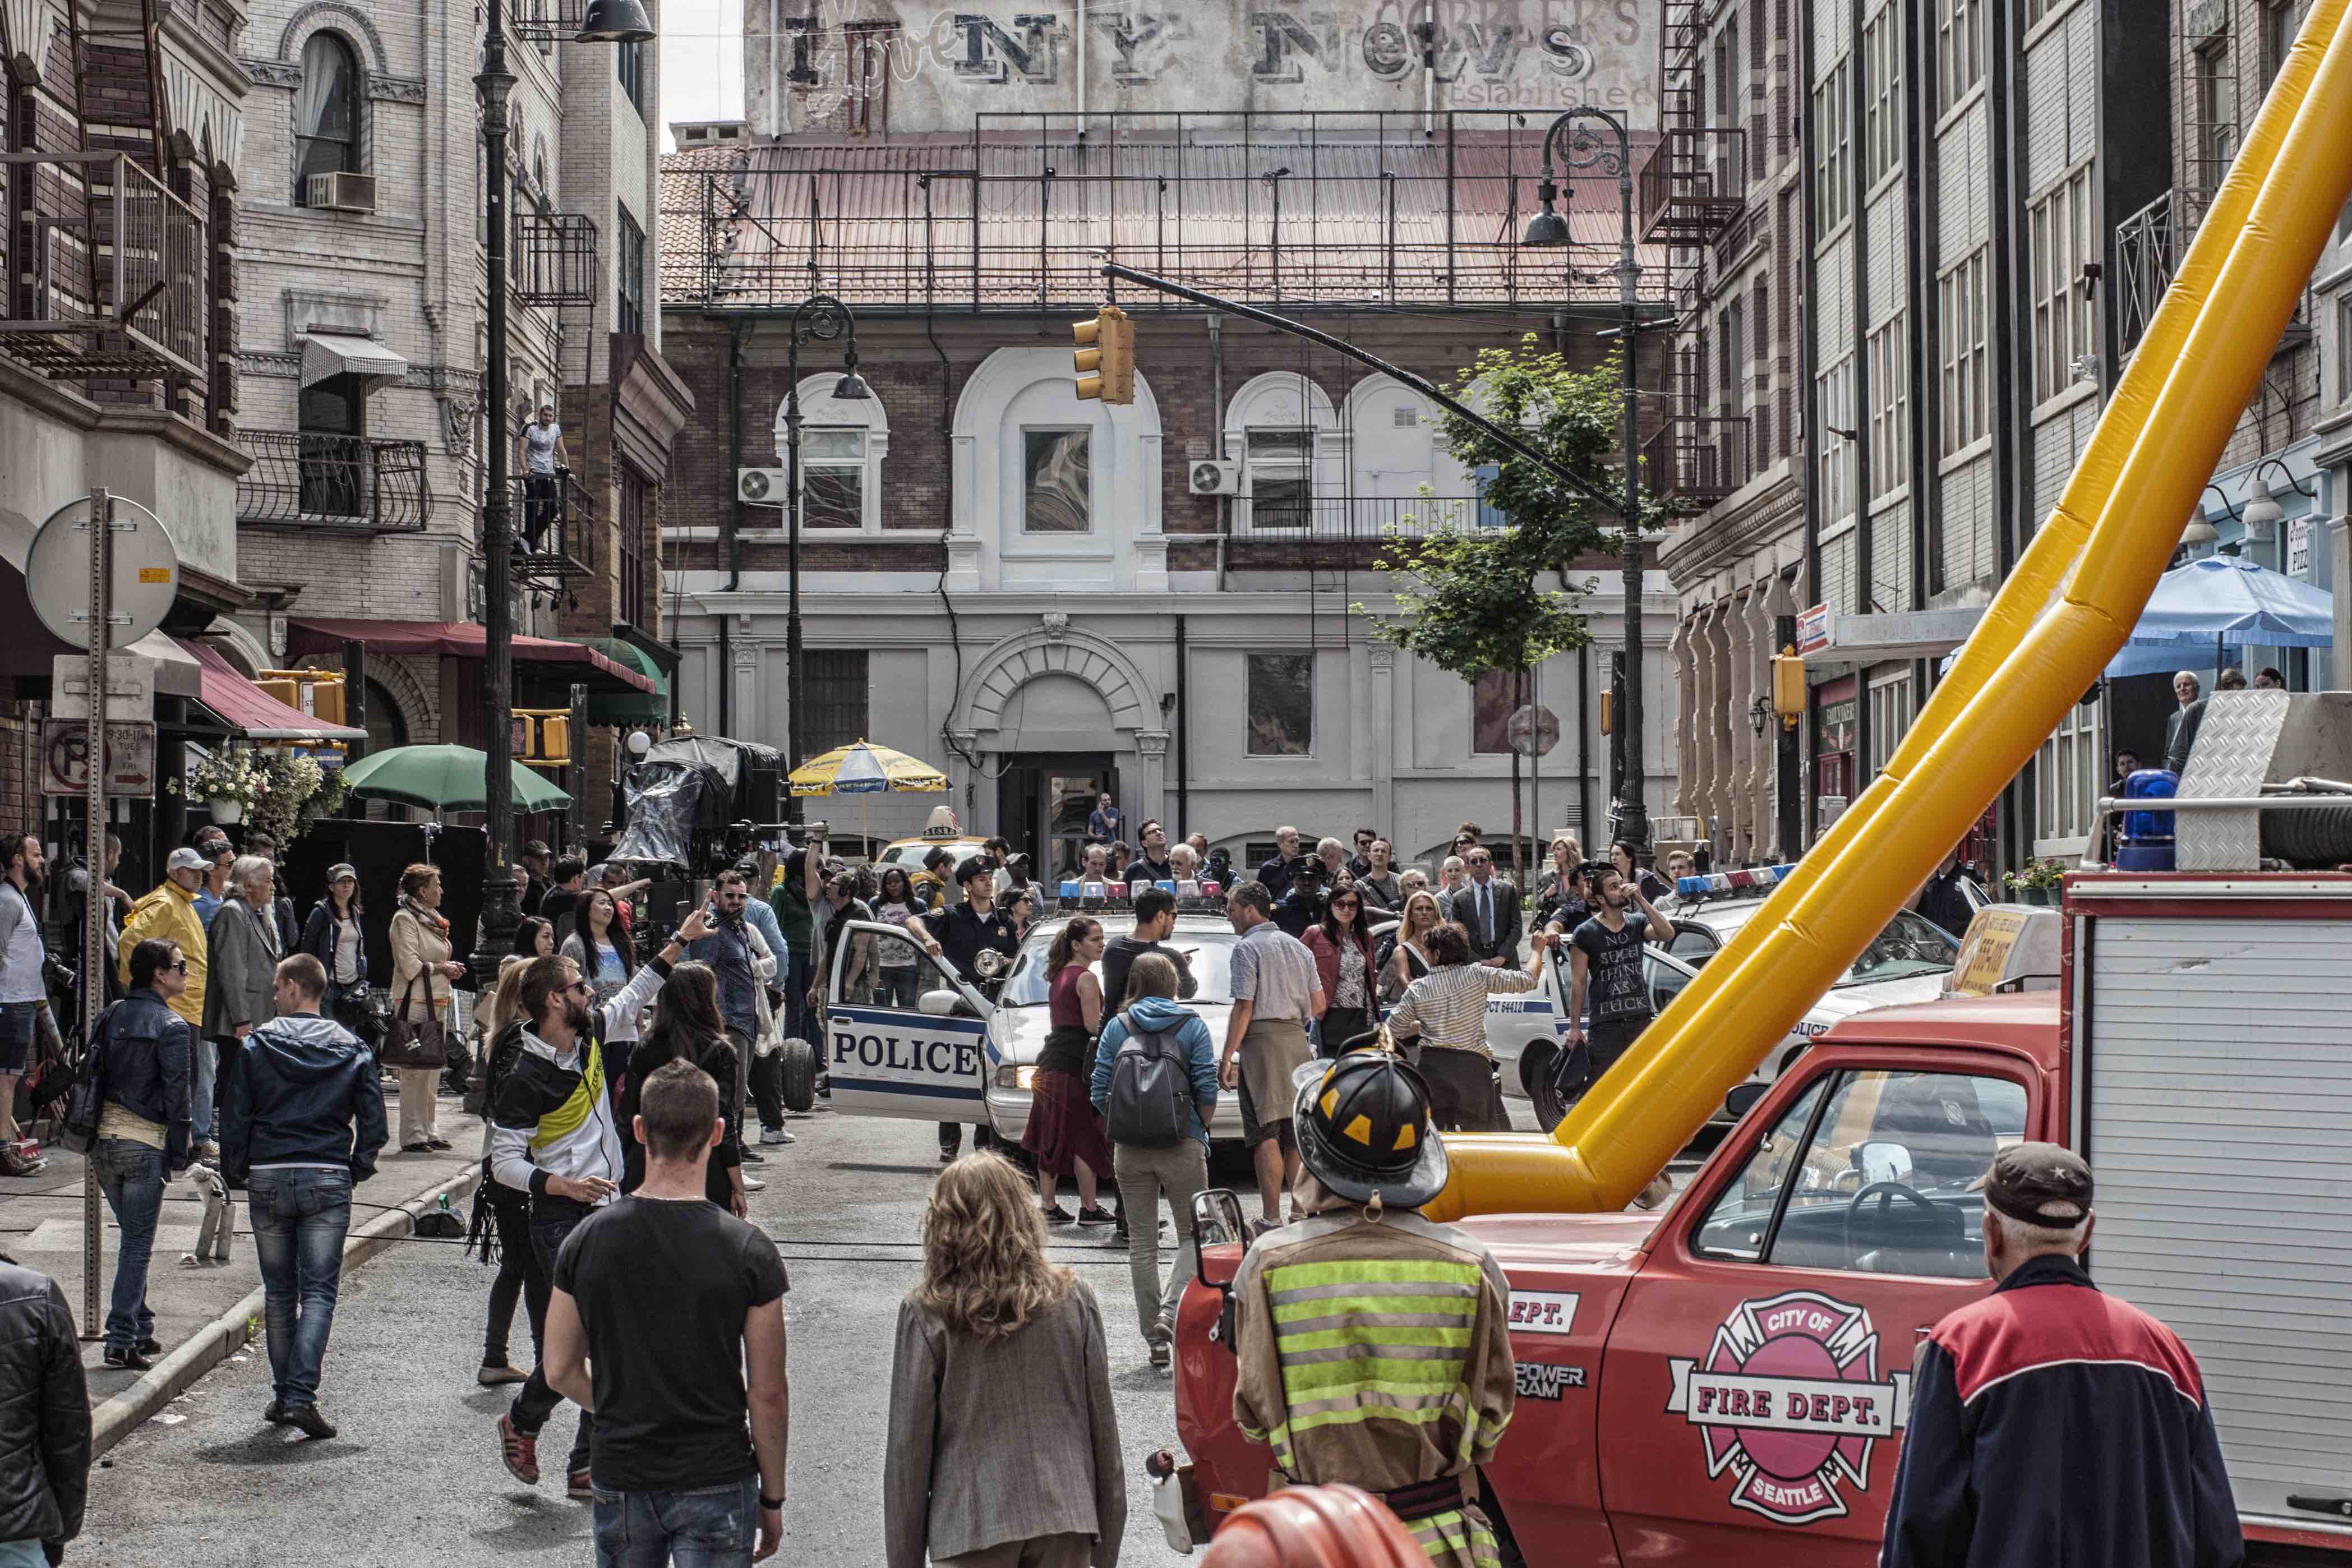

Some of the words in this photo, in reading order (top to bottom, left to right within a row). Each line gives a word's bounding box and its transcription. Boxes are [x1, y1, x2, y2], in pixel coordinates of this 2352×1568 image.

[119, 742, 140, 750] TUES
[1605, 933, 1629, 947] NO
[833, 1032, 977, 1076] POLICE
[1507, 1301, 1563, 1325] EPT.
[1768, 1309, 1807, 1331] CITY
[1808, 1312, 1832, 1332] OF
[1515, 1363, 1585, 1385] POWER
[1515, 1380, 1559, 1398] RAM
[1697, 1386, 1772, 1418] FIRE
[1786, 1392, 1880, 1426] DEPT.
[1752, 1477, 1824, 1506] SEATTLE
